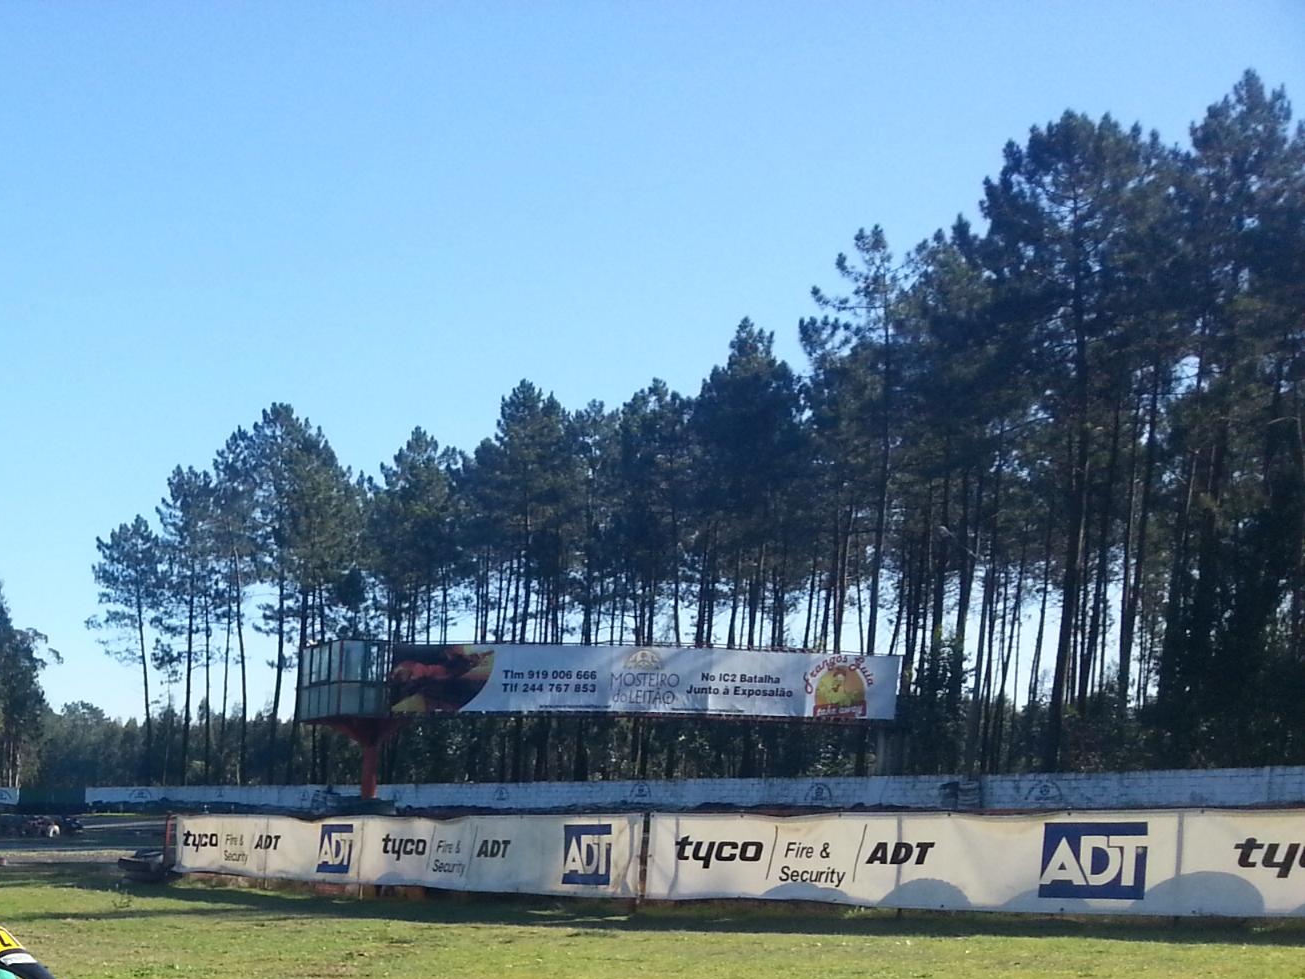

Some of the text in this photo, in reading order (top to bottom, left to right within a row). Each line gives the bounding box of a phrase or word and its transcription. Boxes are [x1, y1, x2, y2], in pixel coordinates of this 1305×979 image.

[503, 670, 597, 680] Tlm 919 006 666
[610, 672, 679, 689] MOSTEIRO
[701, 672, 780, 684] No IC2 Batalha
[522, 683, 543, 693] 244
[548, 683, 570, 693] 767
[574, 683, 596, 693] 853
[686, 685, 719, 695] Junto
[733, 686, 793, 698] Exposalão
[183, 830, 218, 852] tyco
[225, 834, 239, 846] Fire
[254, 834, 281, 850] ADT
[316, 832, 353, 865] ADT
[382, 833, 427, 861] tyco
[436, 840, 454, 854] Fire
[476, 840, 511, 858] ADT
[223, 850, 248, 865] Security
[563, 834, 614, 875] ADT
[675, 834, 764, 869] tyco
[784, 842, 831, 859] Fire &
[865, 842, 935, 865] ADT
[1234, 837, 1305, 878] ty
[432, 859, 466, 877] Security
[1039, 836, 1149, 886] ADT
[779, 866, 846, 887] Security
